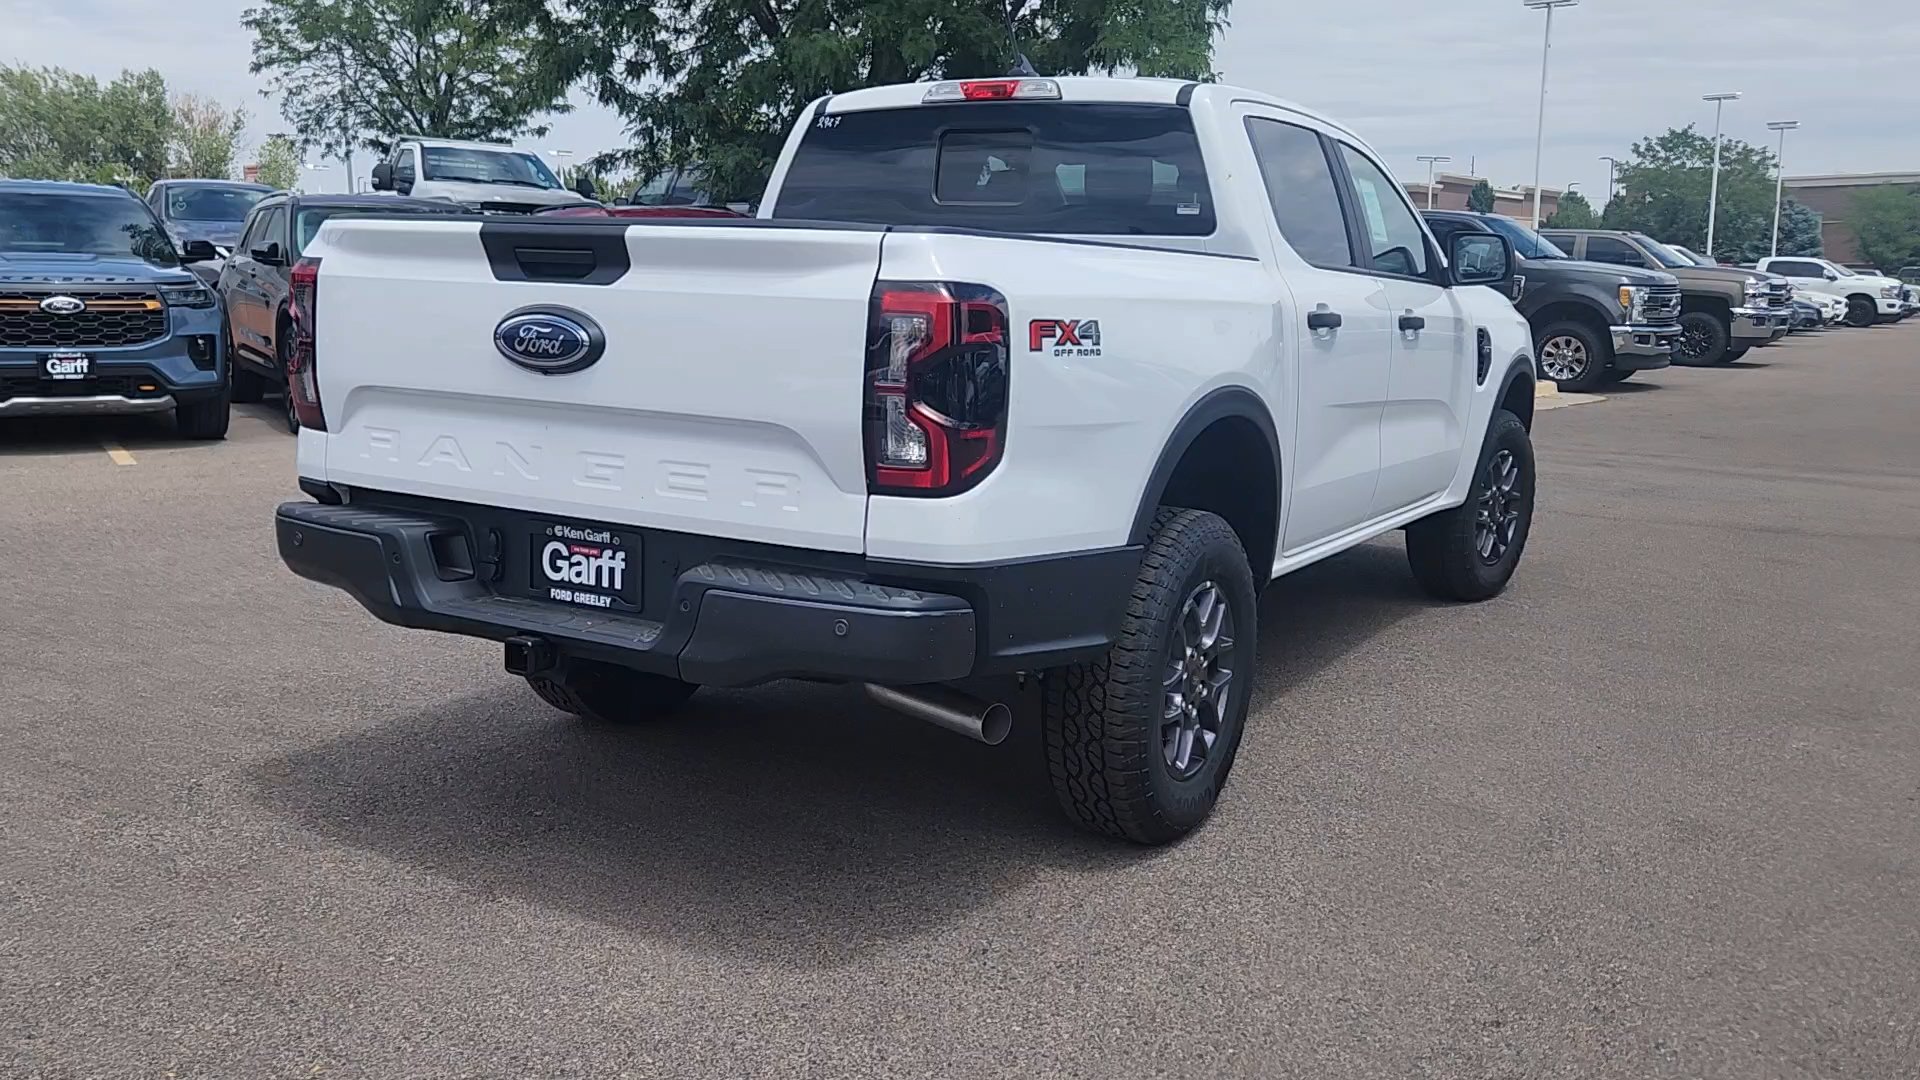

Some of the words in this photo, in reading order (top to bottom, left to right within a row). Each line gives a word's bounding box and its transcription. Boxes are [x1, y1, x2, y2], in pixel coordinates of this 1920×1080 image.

[51, 300, 75, 310] Ford
[514, 324, 564, 354] Ford
[1029, 319, 1101, 352] FX4
[1053, 348, 1074, 357] OFF
[1076, 348, 1102, 357] ROAD
[46, 358, 89, 374] Garff
[359, 425, 800, 512] RANGER
[563, 525, 584, 541] Ken
[584, 529, 611, 544] Garff
[542, 541, 626, 590] Garff
[550, 588, 572, 602] FORD
[573, 591, 612, 608] GREELEY
